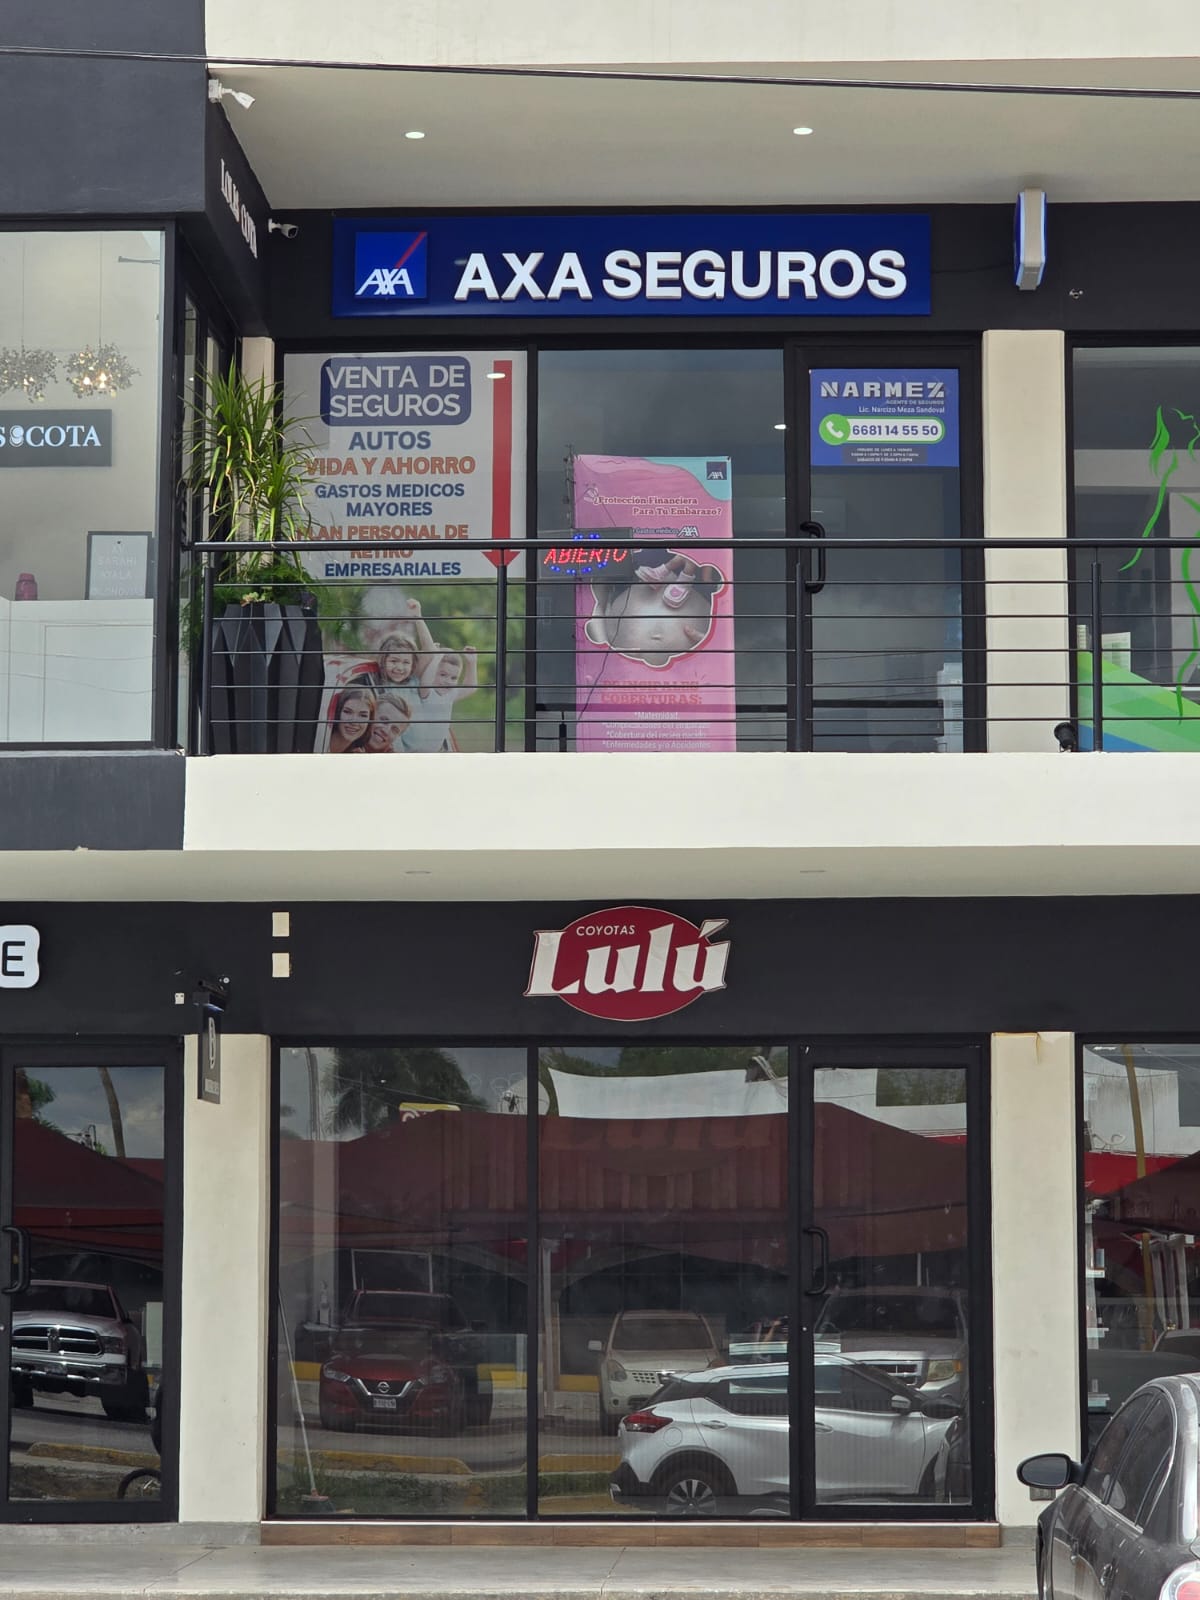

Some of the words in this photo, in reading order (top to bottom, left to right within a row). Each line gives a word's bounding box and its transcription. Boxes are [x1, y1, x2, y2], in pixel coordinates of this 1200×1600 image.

[355, 267, 414, 296] AXA
[454, 251, 592, 301] AXA
[602, 249, 907, 300] SEGUROS
[326, 364, 418, 389] VENTA
[429, 364, 465, 388] DE
[820, 381, 945, 398] NARMEZ
[329, 393, 461, 418] SEGUROS
[25, 425, 102, 447] COTA
[852, 425, 882, 436] 6681
[885, 425, 899, 436] 14
[902, 425, 918, 436] 55
[922, 425, 939, 436] 50
[348, 430, 432, 451] AUTOS
[305, 457, 358, 476] VIDA
[362, 457, 378, 475] Y
[380, 456, 476, 475] AHORRO
[706, 471, 724, 480] AXA
[314, 484, 382, 498] GASTOS
[386, 483, 465, 498] MEDICOS
[648, 496, 698, 505] Financiera
[346, 501, 433, 517] MAYORES
[632, 506, 654, 516] Para
[656, 506, 669, 516] Tu
[670, 506, 722, 516] Embarazo?
[348, 524, 441, 540] PERSONAL
[445, 524, 469, 540] DE
[678, 526, 699, 537] AXA
[543, 547, 628, 565] ABIERTO
[325, 562, 462, 577] EMPRESARIALES
[576, 924, 636, 936] COYOTAS
[524, 920, 731, 996] Lulú
